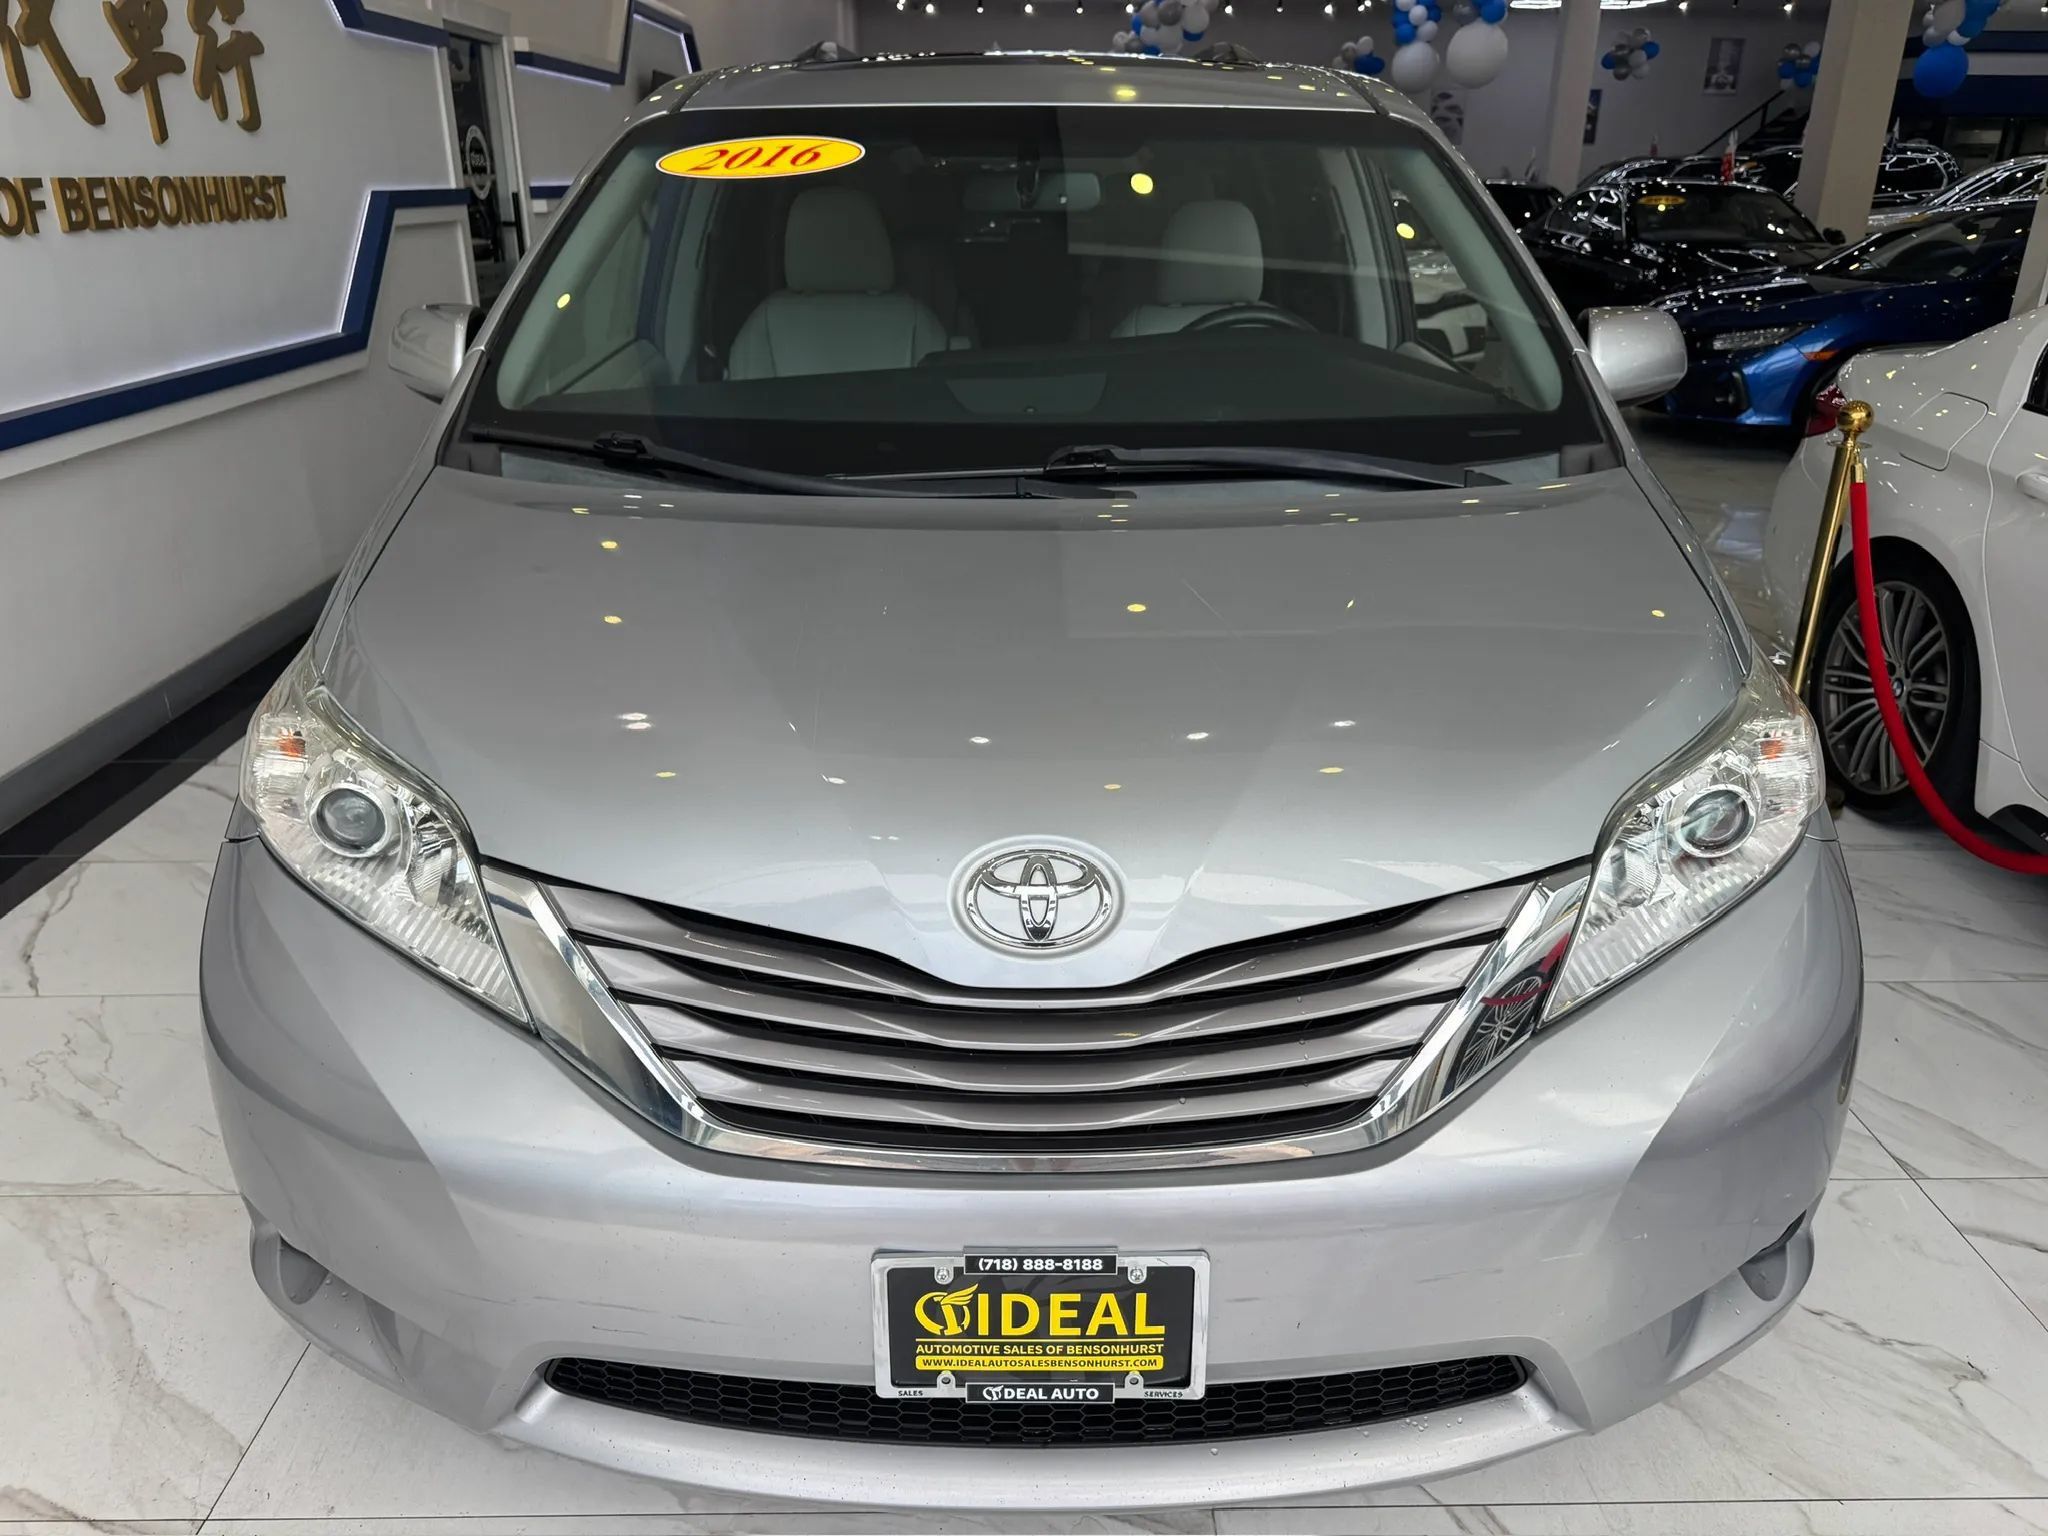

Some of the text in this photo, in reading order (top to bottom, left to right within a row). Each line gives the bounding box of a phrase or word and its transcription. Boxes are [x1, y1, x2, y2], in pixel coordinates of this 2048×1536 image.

[686, 142, 833, 171] 2016
[0, 175, 288, 237] OF BENSONHURST
[978, 1258, 1103, 1271] (718) 888-8188
[977, 1292, 1166, 1336] IDEAL
[915, 1343, 1164, 1355] AUTOMOTIVE SALES OF BENSONHURST
[922, 1358, 1158, 1368] WWW.IDEALAUTOSALESBENSONHURST.COM
[897, 1389, 924, 1398] SALES
[1050, 1387, 1099, 1400] AUTO
[1143, 1390, 1184, 1399] SERVICES
